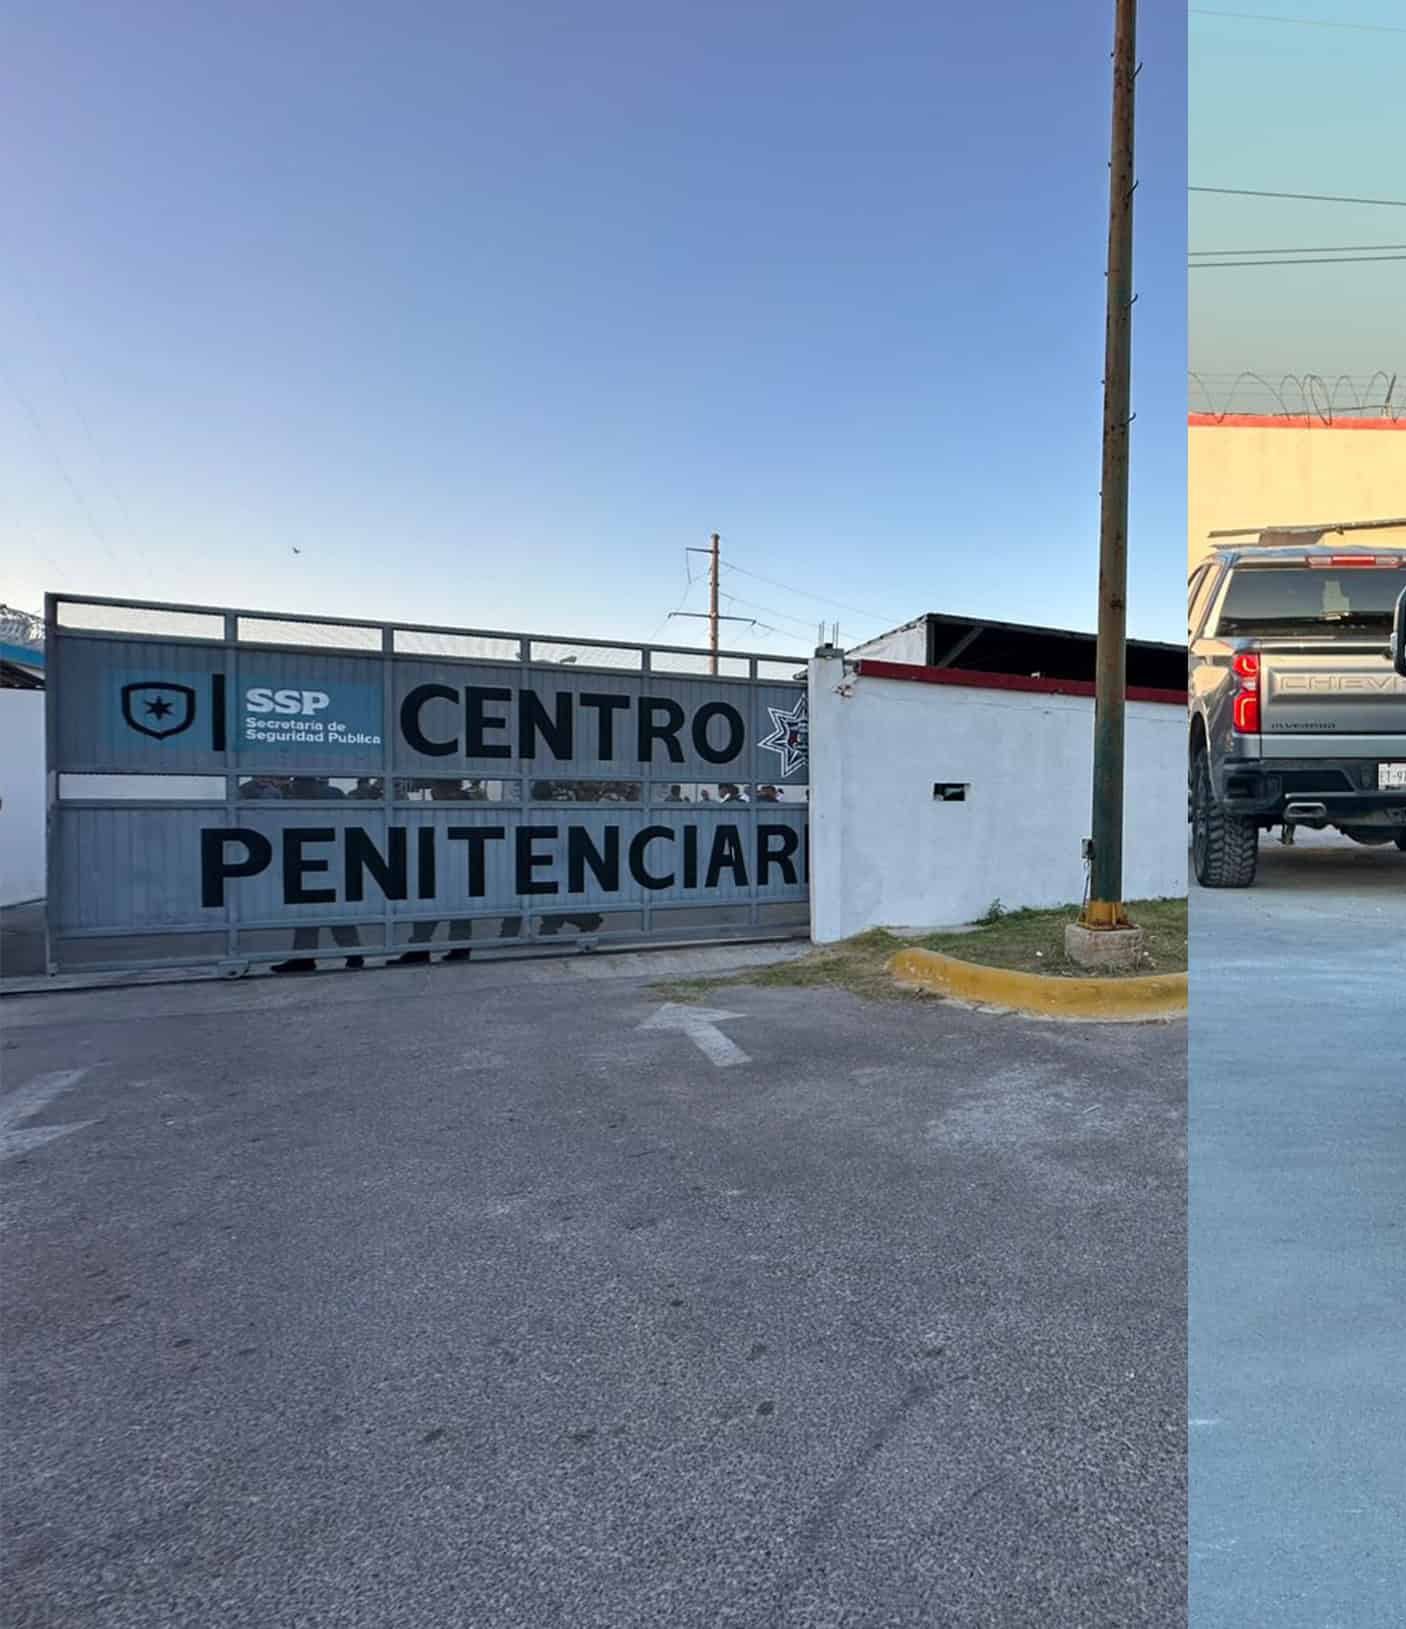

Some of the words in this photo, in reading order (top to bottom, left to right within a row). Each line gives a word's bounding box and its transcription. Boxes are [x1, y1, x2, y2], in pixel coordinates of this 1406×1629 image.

[246, 688, 330, 715] SSP
[327, 721, 347, 732] de
[400, 683, 745, 765] CENTRO
[245, 729, 325, 743] Seguridad
